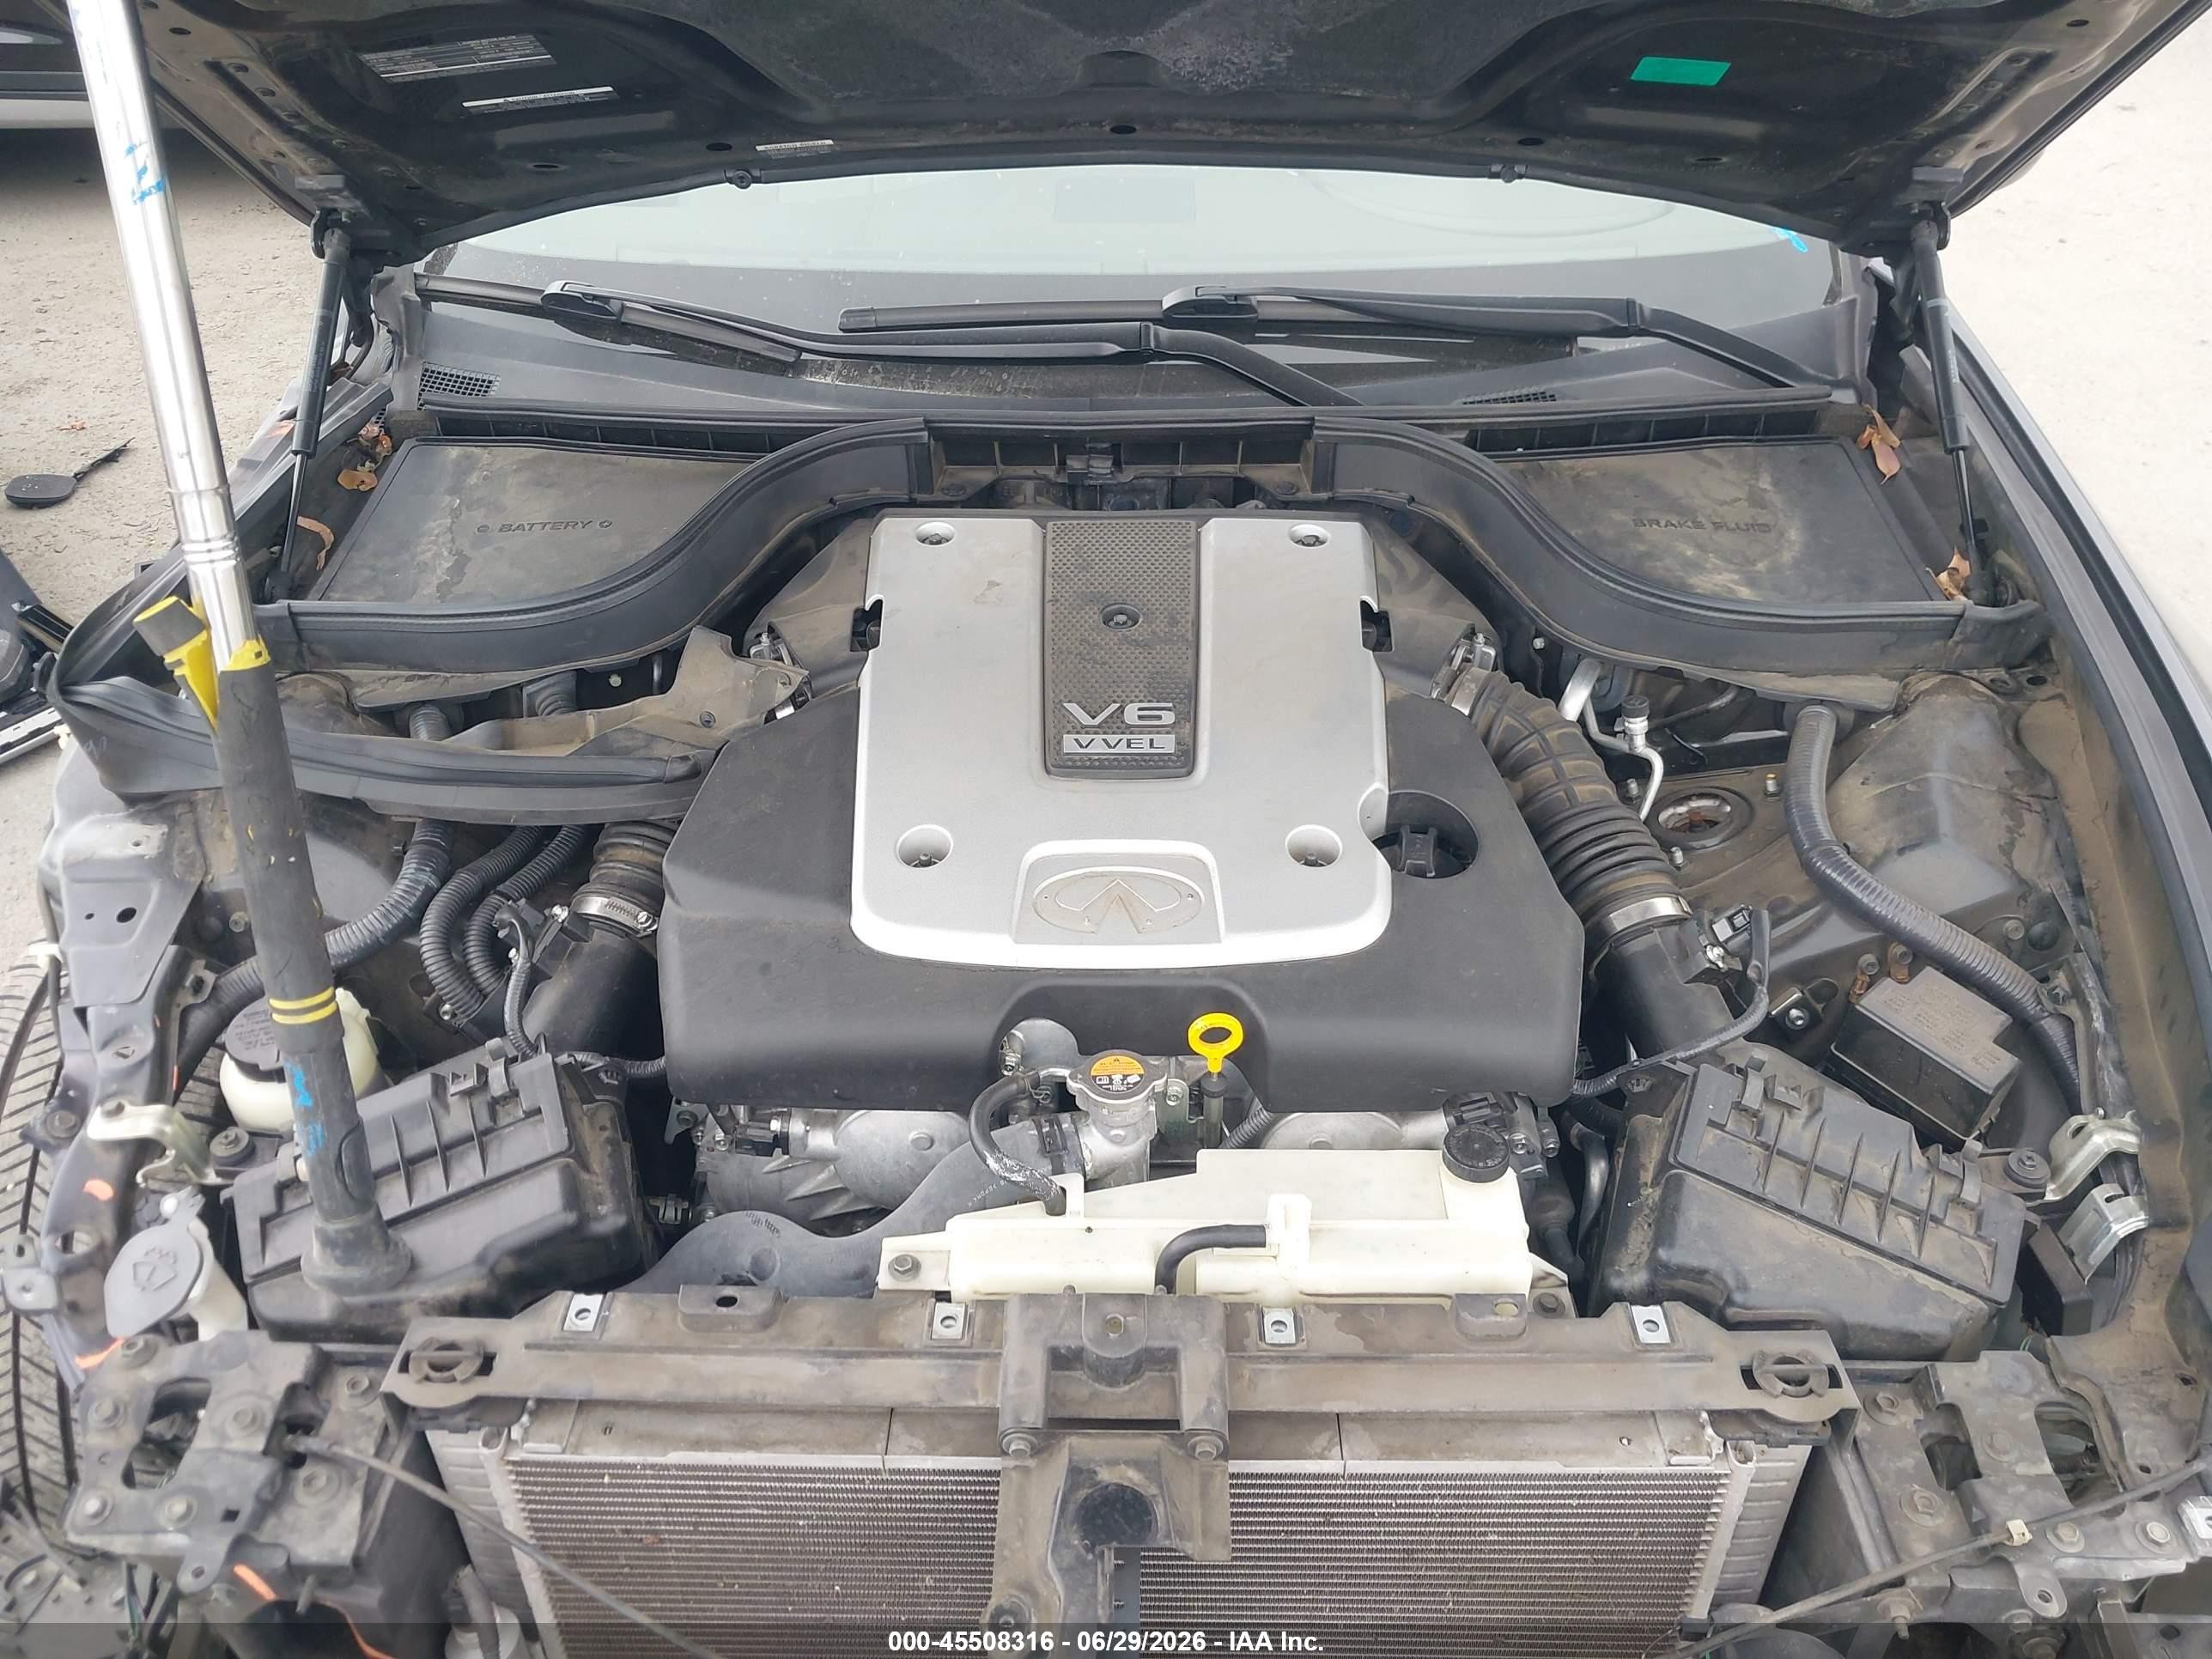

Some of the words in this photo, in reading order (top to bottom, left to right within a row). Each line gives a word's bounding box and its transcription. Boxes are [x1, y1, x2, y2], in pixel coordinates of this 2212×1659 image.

[497, 520, 593, 533] BATTERY
[1633, 519, 1706, 530] BRAKE
[1711, 521, 1772, 533] FLUID
[1062, 702, 1176, 726] V6
[1073, 738, 1167, 750] VVEL
